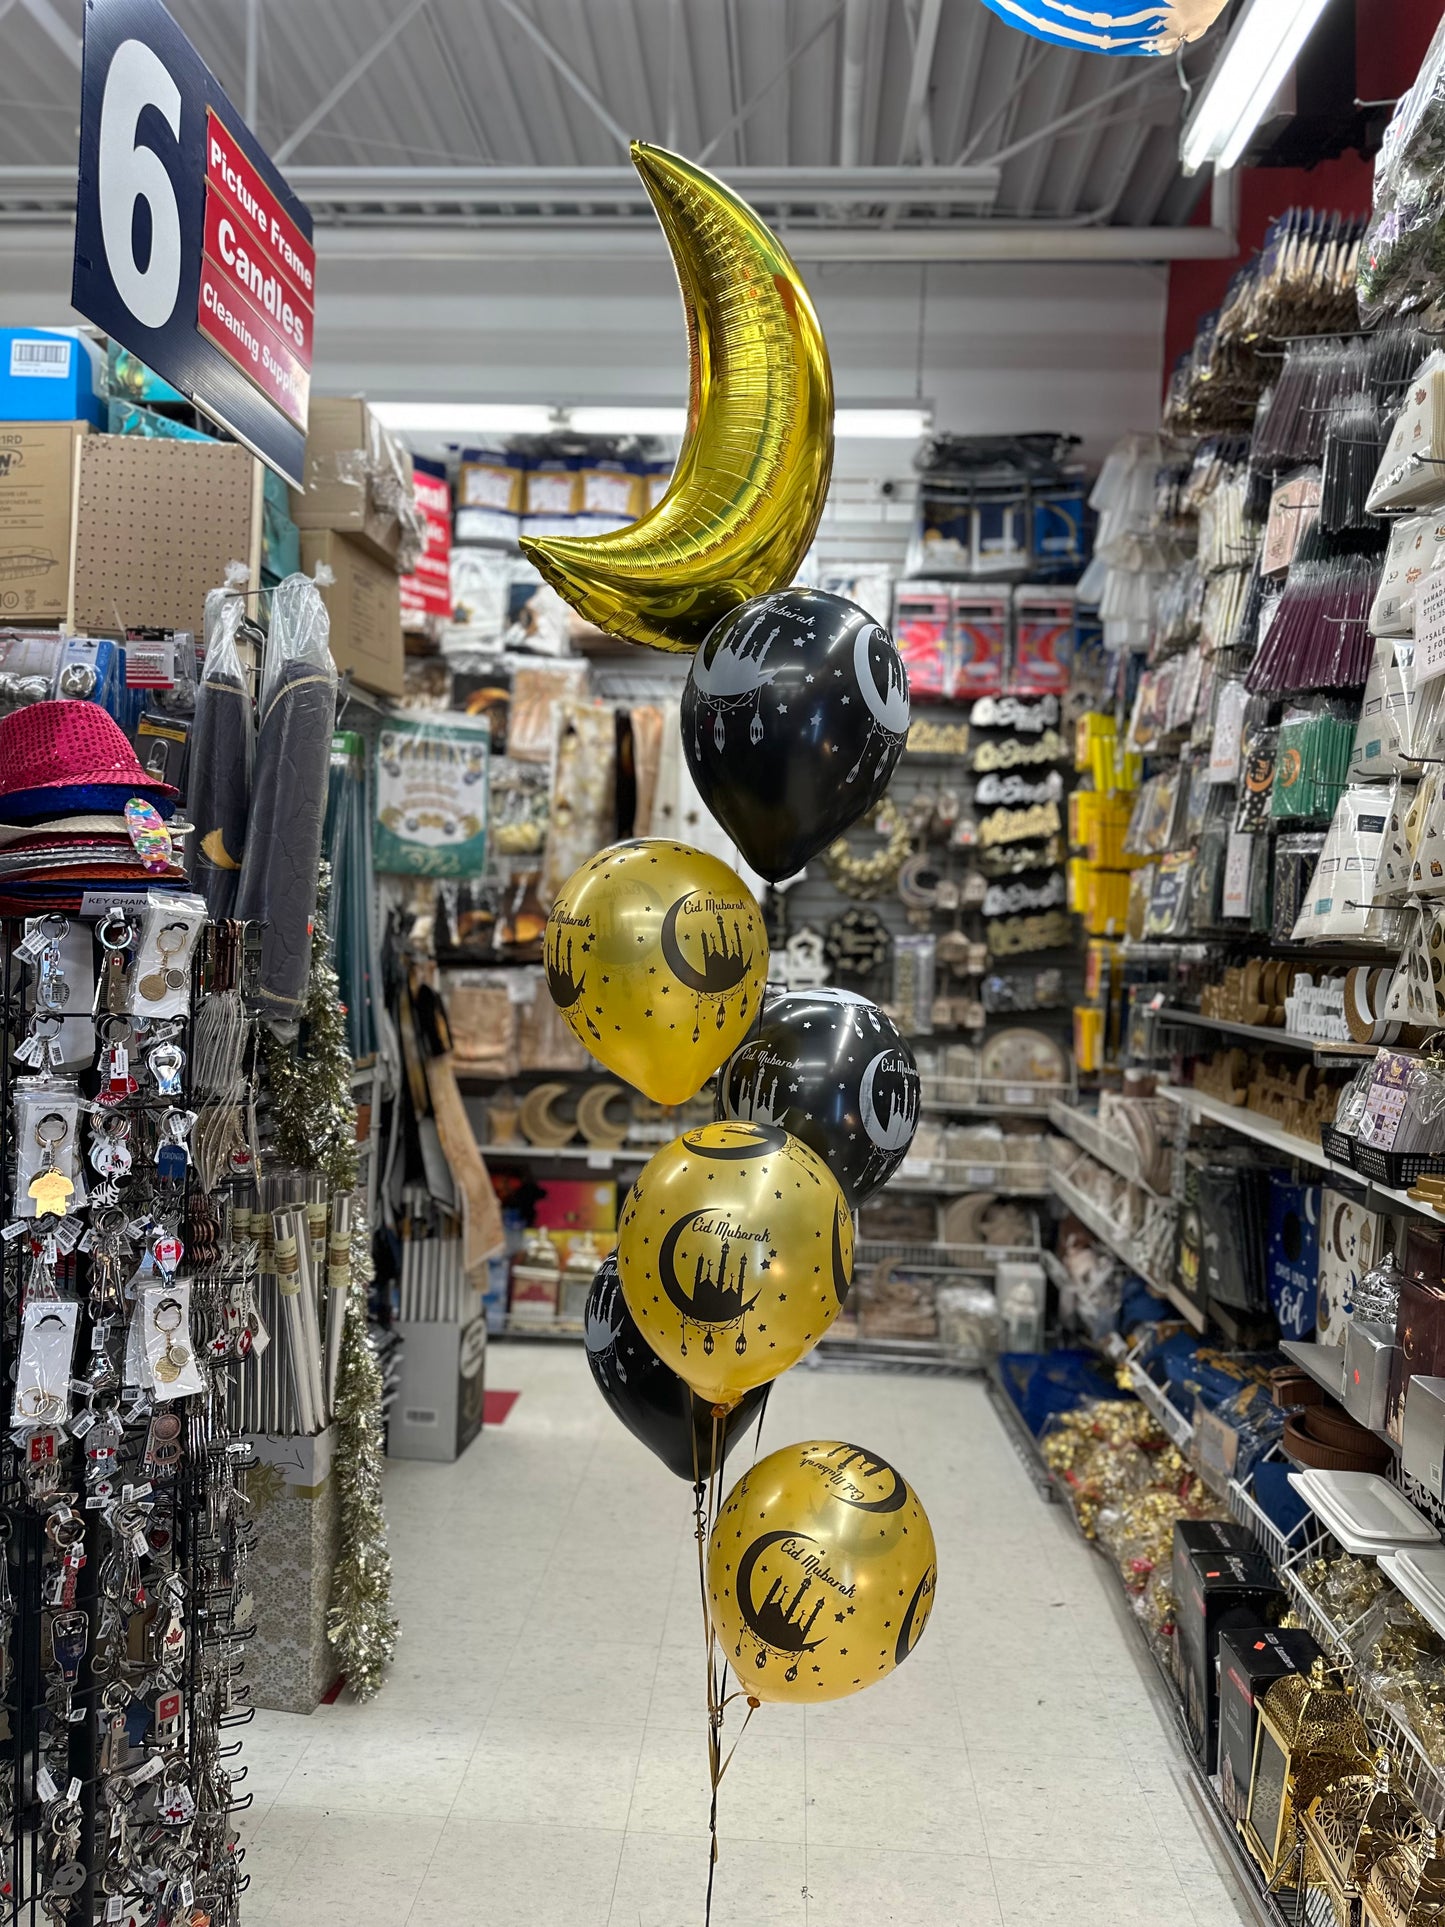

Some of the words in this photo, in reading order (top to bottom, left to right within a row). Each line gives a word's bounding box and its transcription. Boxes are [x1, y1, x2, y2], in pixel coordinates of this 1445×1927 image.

[100, 38, 182, 328] 6
[211, 137, 267, 233] Picture
[270, 217, 312, 290] Frame
[218, 218, 304, 347] Candles
[203, 282, 259, 362] Cleaning
[1431, 580, 1442, 590] ALL
[1423, 598, 1445, 617] STICKE
[556, 911, 591, 928] Mubarak
[683, 899, 703, 915] Eid
[705, 898, 746, 915] Mubarak
[742, 1047, 755, 1061] Eid
[757, 1050, 802, 1070] Mubarak
[881, 1057, 896, 1073] Eid
[692, 1216, 713, 1234] Eid
[714, 1221, 772, 1243] Mubarak
[1279, 1285, 1305, 1336] Eid
[800, 1458, 847, 1486] Mubarak
[843, 1482, 865, 1501] Eid
[781, 1538, 805, 1561] Eid
[801, 1554, 857, 1599] Mubarak
